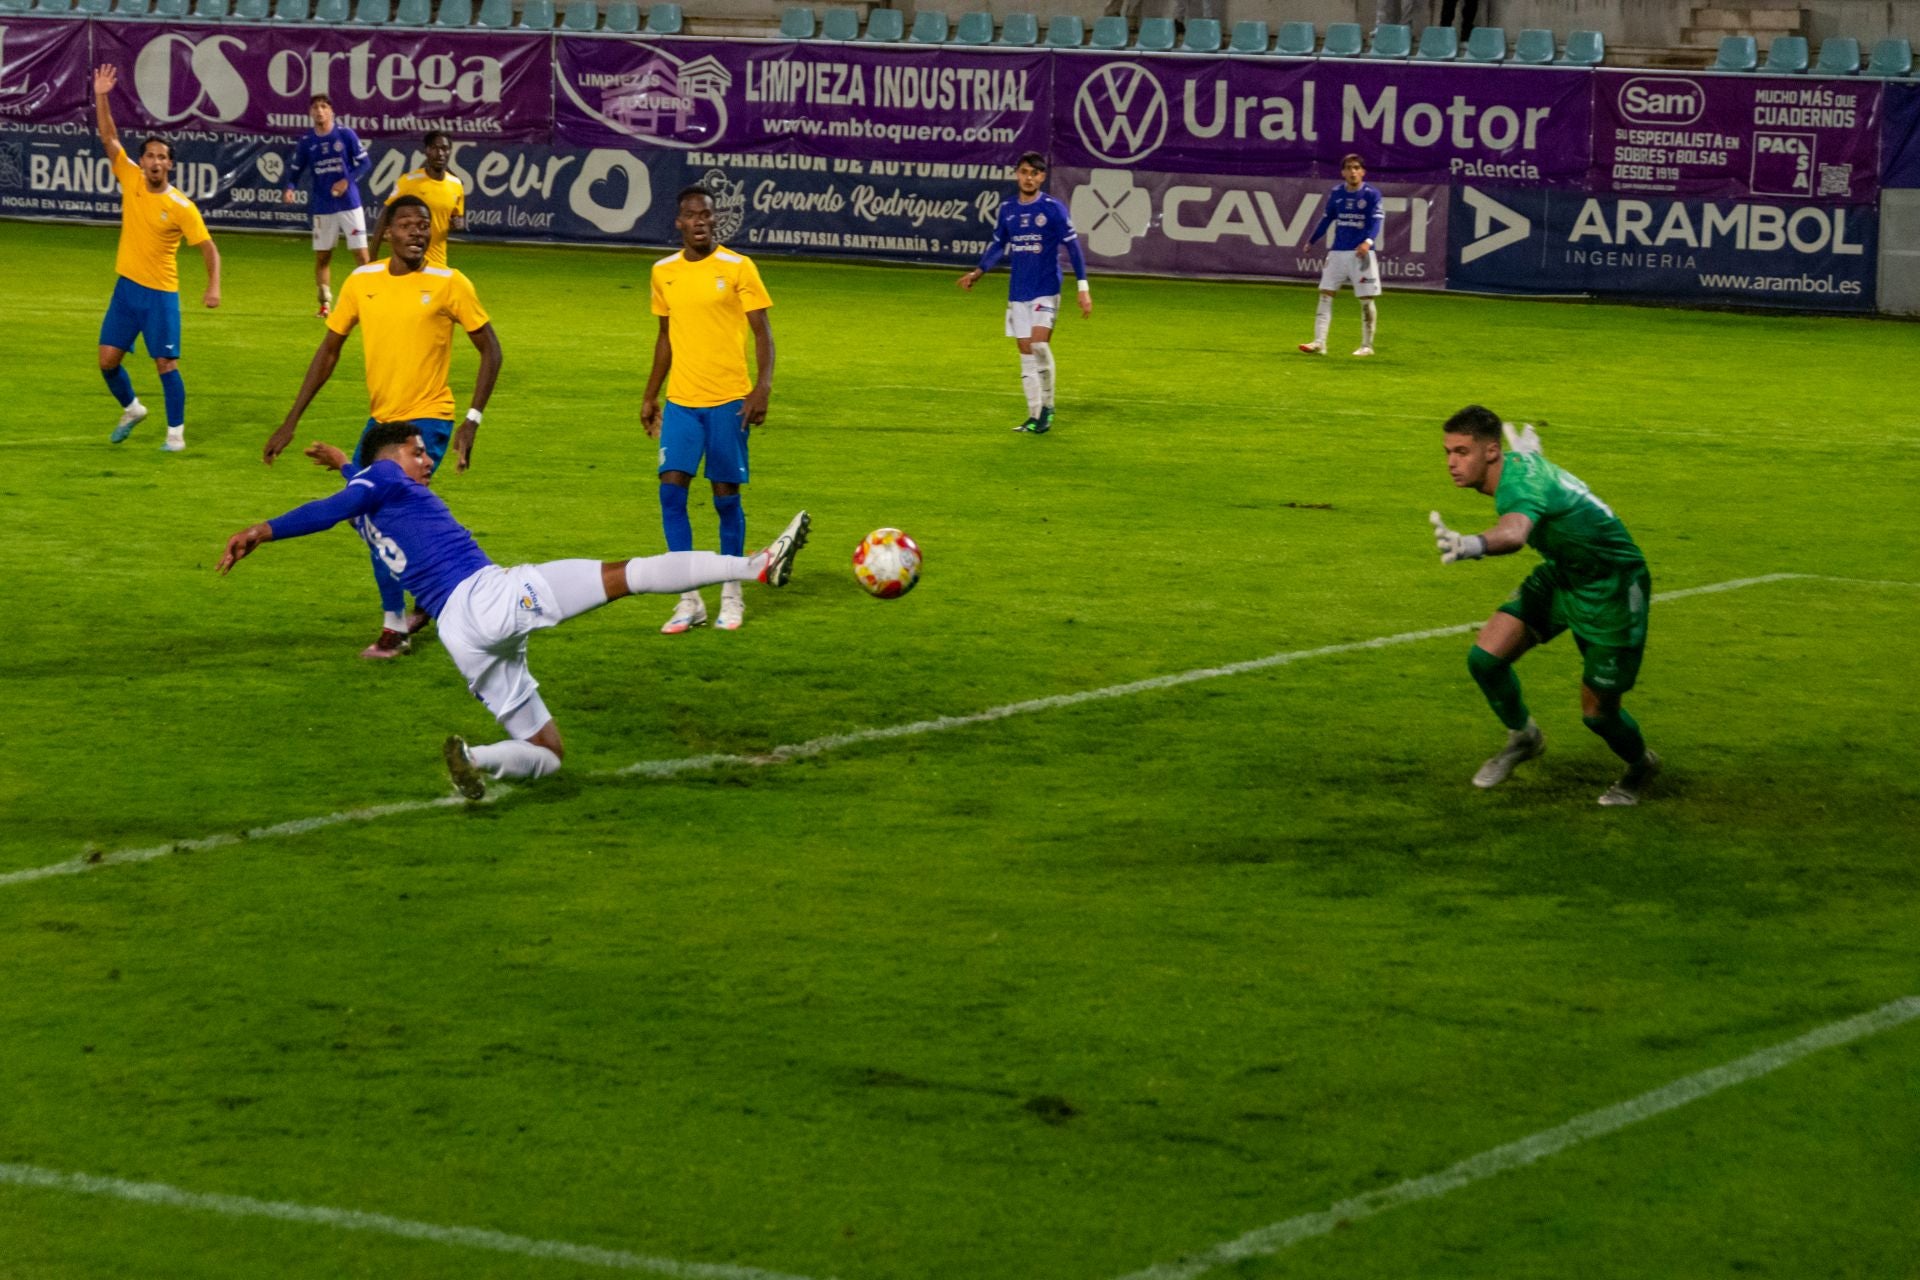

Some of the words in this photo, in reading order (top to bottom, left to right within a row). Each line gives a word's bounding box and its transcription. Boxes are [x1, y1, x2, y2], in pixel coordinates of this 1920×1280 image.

[578, 72, 661, 87] LIMPIEZAS
[744, 60, 866, 107] LIMPIEZA
[873, 65, 1034, 112] INDUSTRIAL
[1625, 86, 1695, 115] Sam
[1755, 89, 1798, 104] MUCHO
[1800, 85, 1834, 107] MÁS
[1835, 95, 1857, 108] QUE
[383, 113, 502, 133] industriales
[1183, 80, 1317, 141] Ural
[1341, 85, 1551, 150] Motor
[1753, 106, 1857, 128] CUADERNOS
[762, 118, 1015, 144] www.mbtoquero.com
[1628, 130, 1722, 149] ESPECIALISTA
[1725, 136, 1740, 149] EN
[1614, 146, 1666, 164] SOBRES
[1675, 149, 1728, 166] BOLSAS
[869, 159, 1018, 181] AUTOMOVILE
[1450, 158, 1540, 179] Palencia
[1612, 164, 1654, 180] DESDE
[1656, 166, 1680, 180] 1919
[2, 196, 39, 208] HOGAR
[41, 198, 56, 209] EN
[58, 200, 94, 212] VENTA
[95, 202, 111, 212] DE
[230, 187, 255, 203] 900
[257, 188, 283, 203] 802
[284, 189, 309, 205] 03
[752, 179, 847, 214] Gerardo
[850, 184, 969, 227] Rodríguez
[260, 210, 273, 220] DE
[275, 211, 309, 222] TRENES
[465, 209, 502, 232] para
[507, 205, 556, 227] llevar
[1567, 198, 1864, 255] ARAMBOL
[749, 229, 764, 243] C/
[767, 229, 840, 247] ANASTASIA
[843, 234, 928, 251] SANTAMARÍA
[930, 239, 940, 252] 3
[1566, 250, 1698, 269] INGENIERIA
[1699, 273, 1862, 295] www.arambol.es
